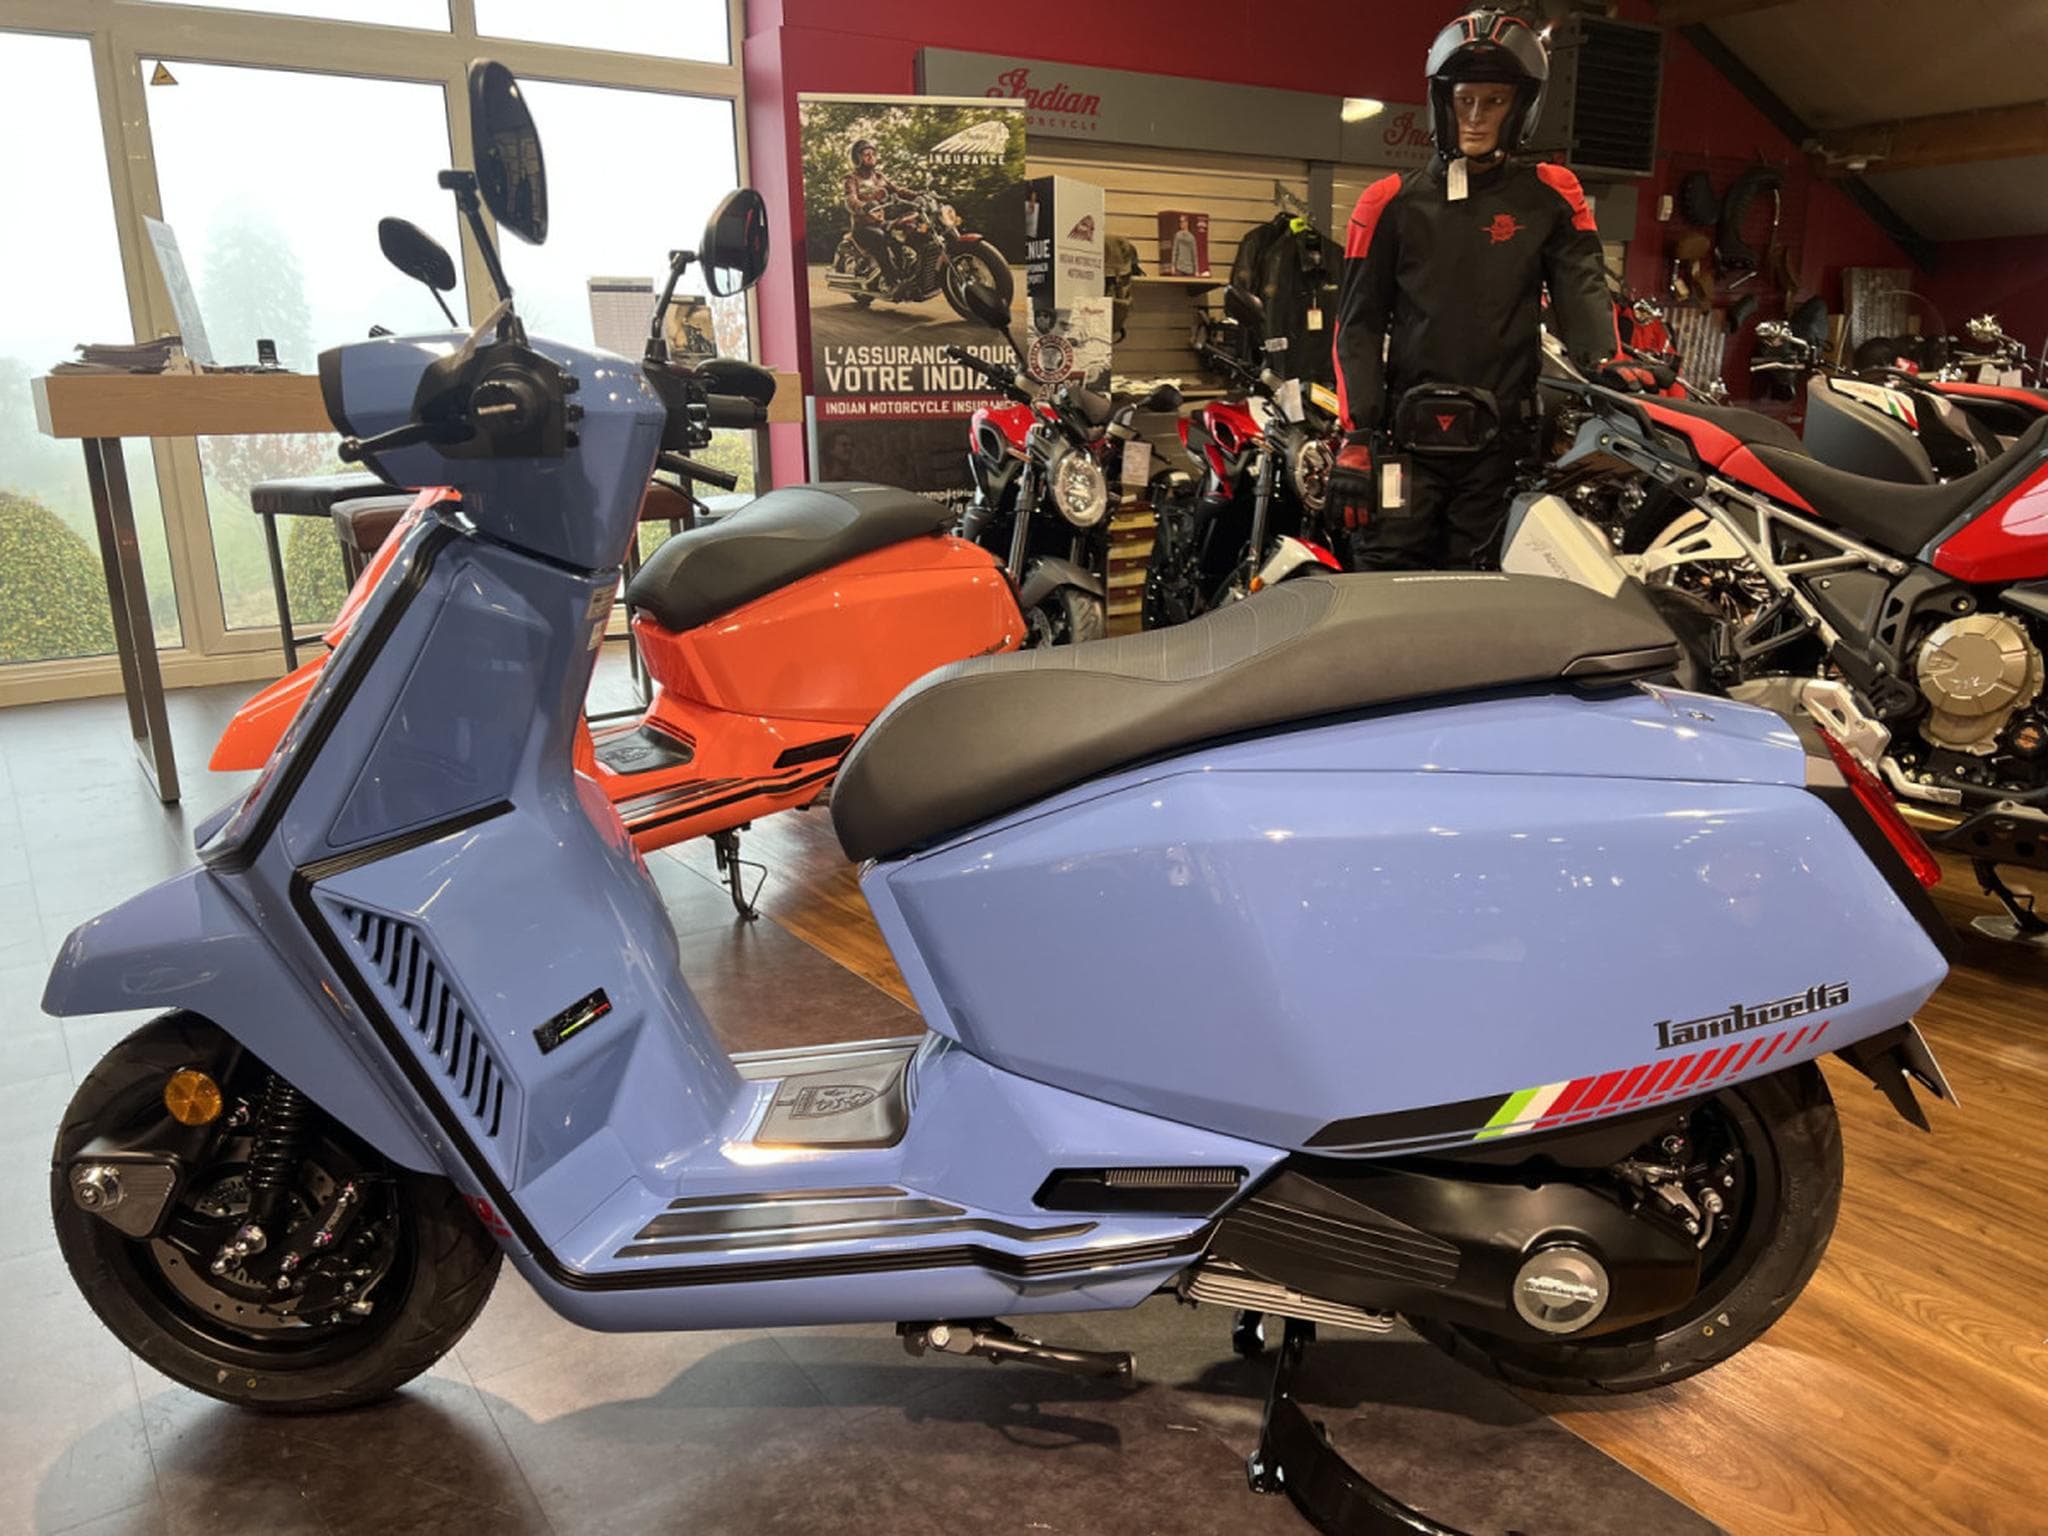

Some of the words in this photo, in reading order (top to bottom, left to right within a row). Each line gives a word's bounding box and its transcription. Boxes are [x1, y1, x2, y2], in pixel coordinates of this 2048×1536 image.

[986, 68, 1101, 116] Indian
[1026, 116, 1097, 131] ORCYCLE
[929, 154, 1005, 166] INSURANCE
[967, 345, 1017, 364] POUR
[825, 366, 914, 392] VOTRE
[923, 365, 996, 391] INDIA
[825, 402, 866, 415] INDIAN
[870, 401, 949, 414] MOTORCYCLE
[1653, 981, 1849, 1050] Lambretta
